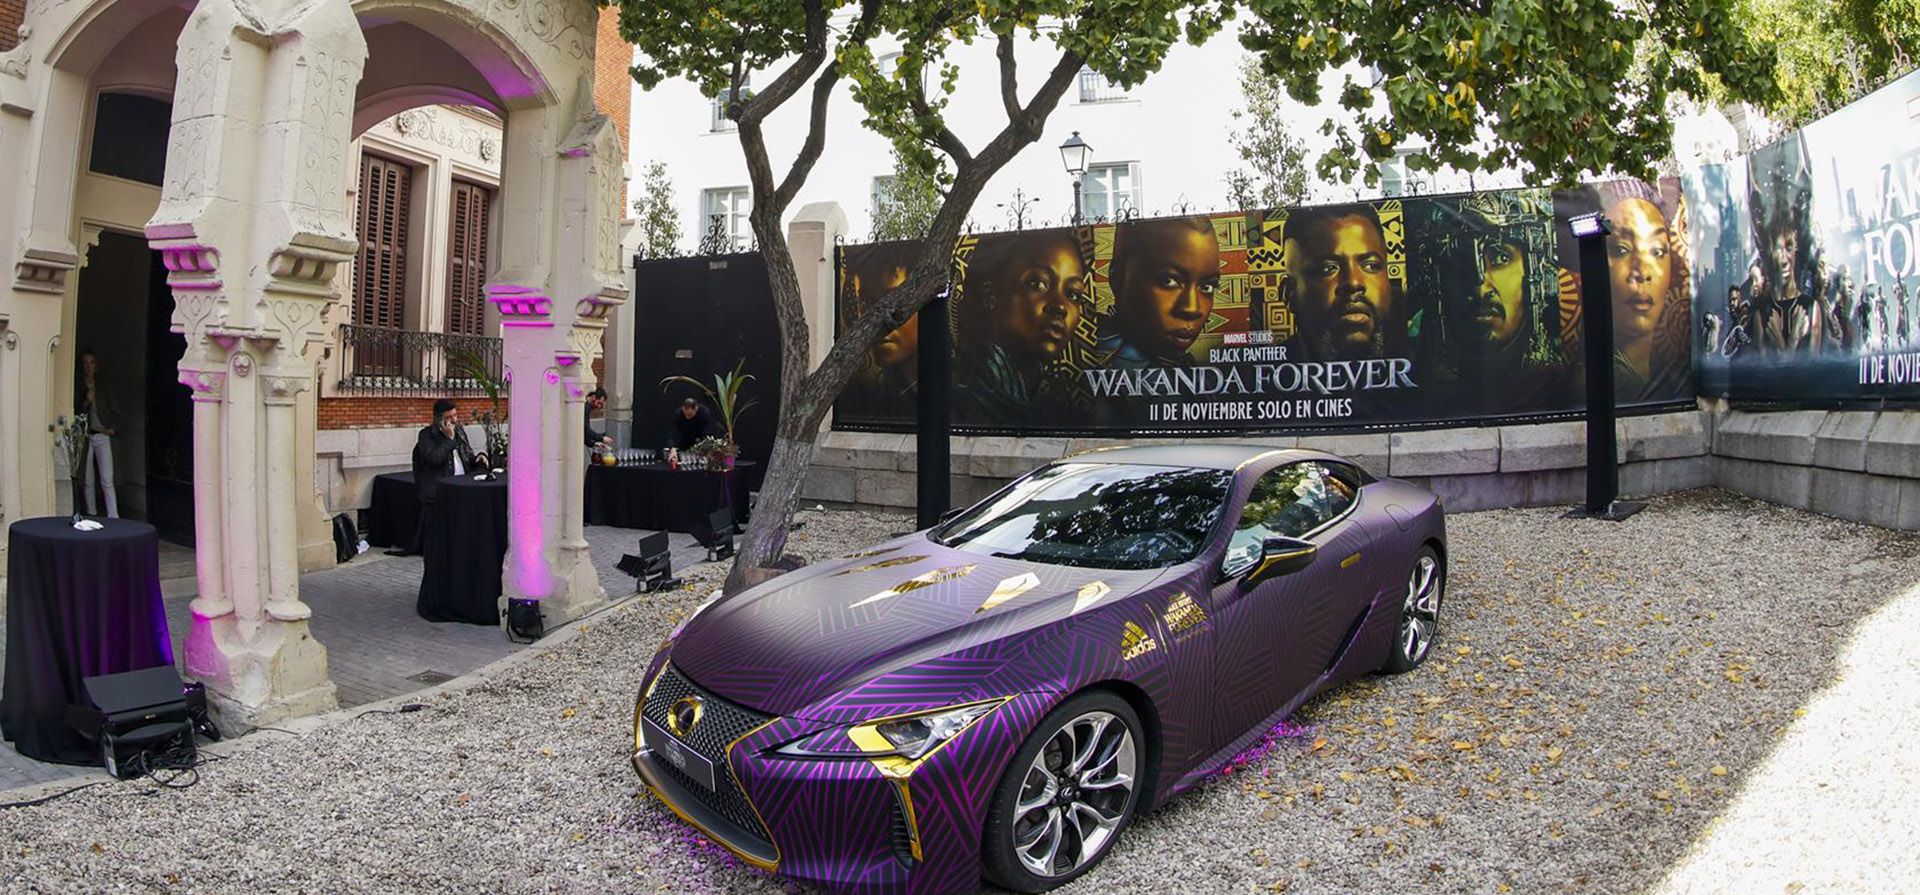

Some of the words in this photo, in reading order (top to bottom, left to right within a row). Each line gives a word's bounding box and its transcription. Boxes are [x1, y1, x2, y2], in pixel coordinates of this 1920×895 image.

[1224, 333, 1247, 344] MARVEL
[1248, 330, 1274, 344] STUDIOS
[1209, 348, 1240, 363] BLACK
[1243, 346, 1287, 361] PANTHER
[1085, 367, 1249, 397] WAKANDA
[1253, 358, 1418, 395] FOREVER
[1871, 355, 1885, 384] DE
[1163, 403, 1179, 420] DE
[1182, 402, 1253, 421] NOVIEMBRE
[1257, 400, 1291, 419] SOLO
[1296, 399, 1312, 418] EN
[1315, 398, 1352, 418] CINES
[1121, 638, 1157, 661] adidas
